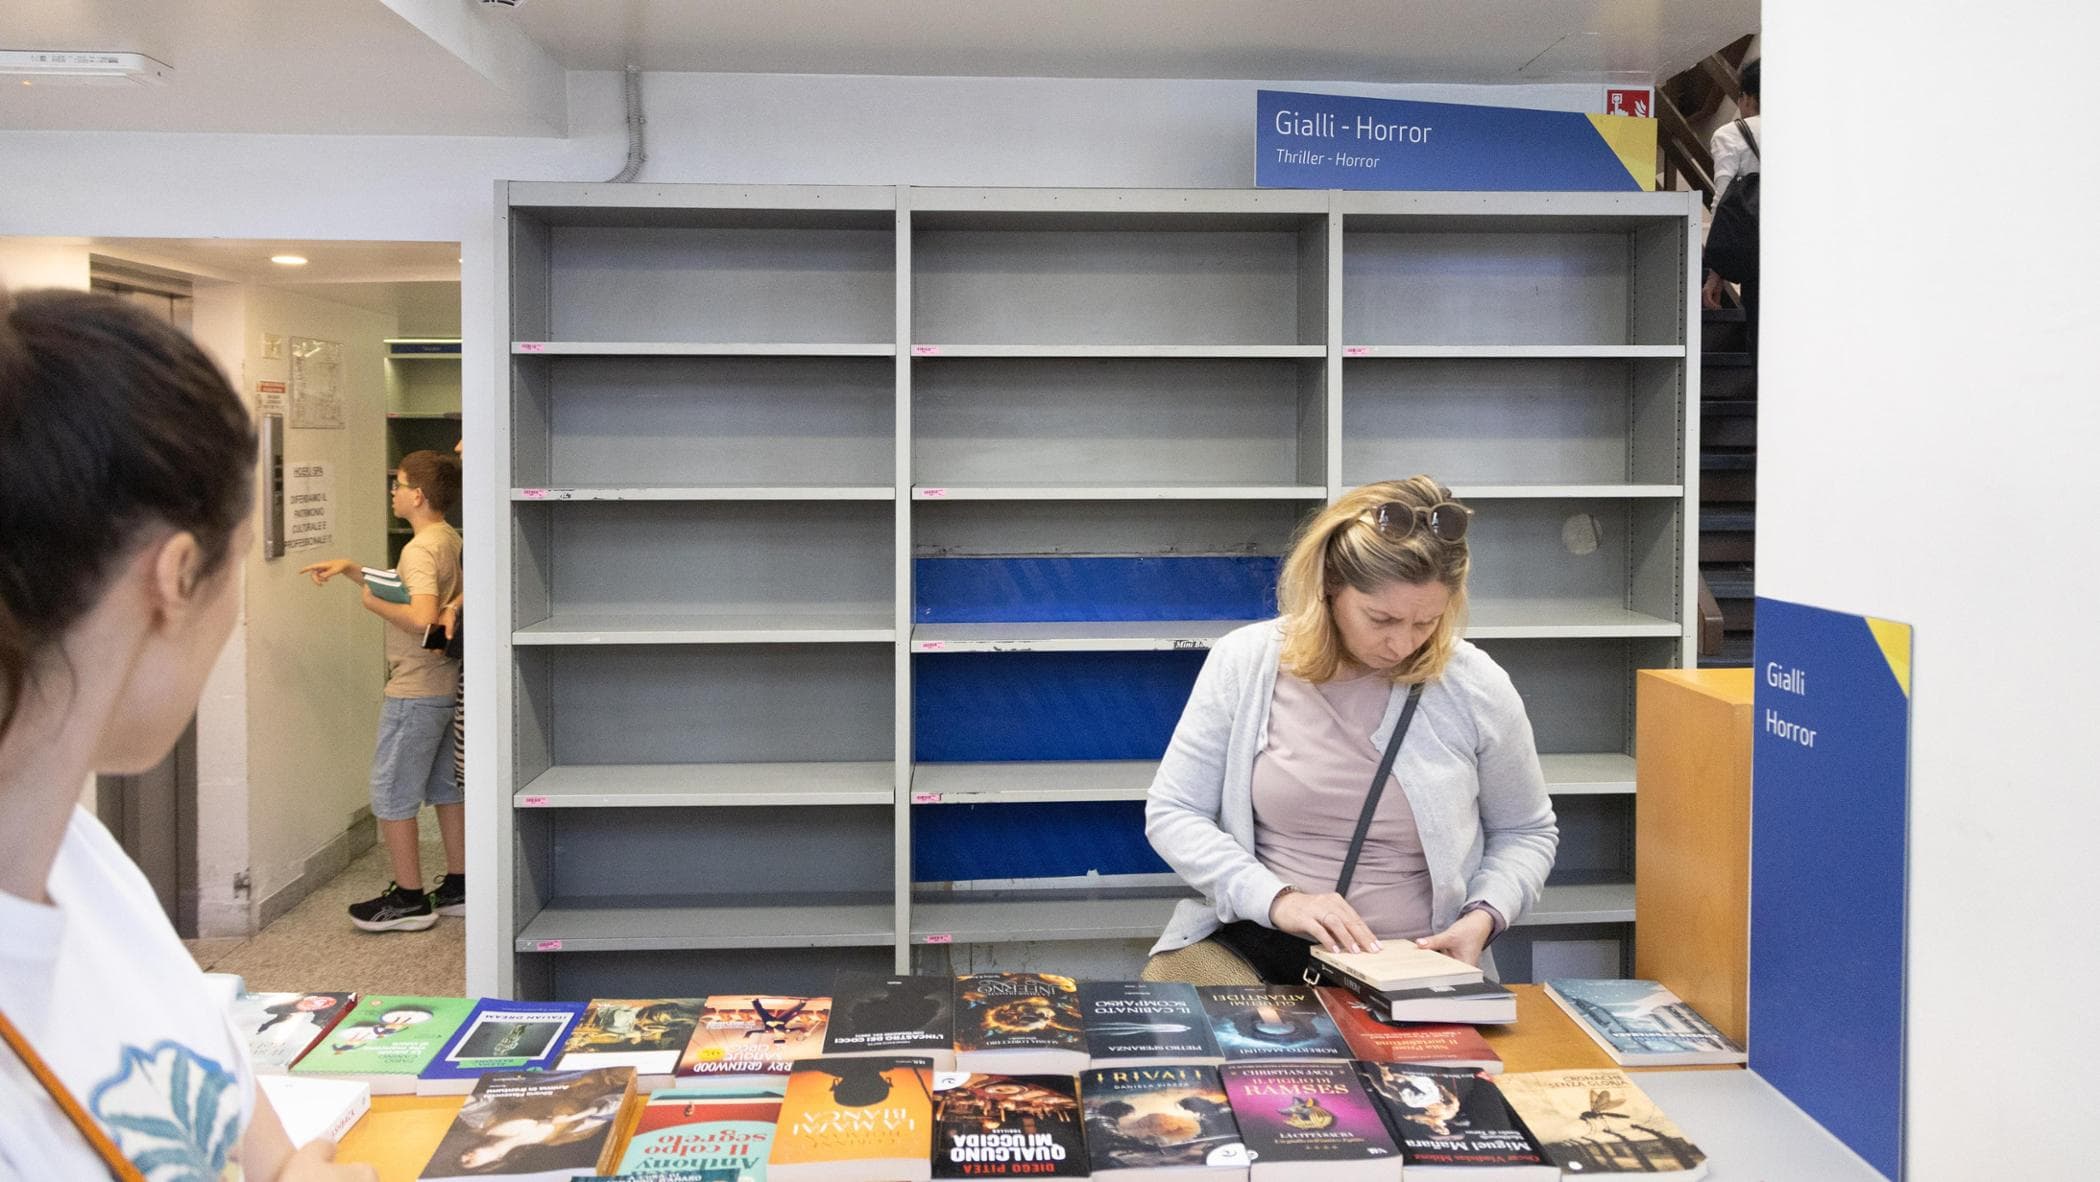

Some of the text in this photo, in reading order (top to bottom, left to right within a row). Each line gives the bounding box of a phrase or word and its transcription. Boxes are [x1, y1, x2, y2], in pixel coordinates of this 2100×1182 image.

[1275, 110, 1335, 138] Gialli
[1356, 115, 1432, 144] Horror
[1276, 148, 1325, 166] Thriller
[1335, 153, 1380, 169] Horror
[1766, 661, 1806, 697] Gialli
[1765, 708, 1817, 748] Horror
[977, 983, 1056, 996] INFERNO
[885, 1033, 944, 1042] L'INCASTRO
[1108, 1044, 1163, 1052] SPERANZA
[692, 1061, 794, 1074] RRY GREENWOOD
[1112, 1070, 1202, 1082] RIVALI
[1267, 1077, 1314, 1085] FIGLIO
[1243, 1083, 1349, 1095] RAMSES
[803, 1107, 907, 1123] BIANCA
[882, 1119, 915, 1132] LA
[953, 1133, 1052, 1147] MI UCCIDA
[1405, 1140, 1532, 1151] Miguel Mañara
[643, 1142, 749, 1157] Il colpo
[950, 1143, 1067, 1162] QUALCUNO
[636, 1157, 760, 1172] Anthony
[962, 1162, 1056, 1174] DIEGO PITEA
